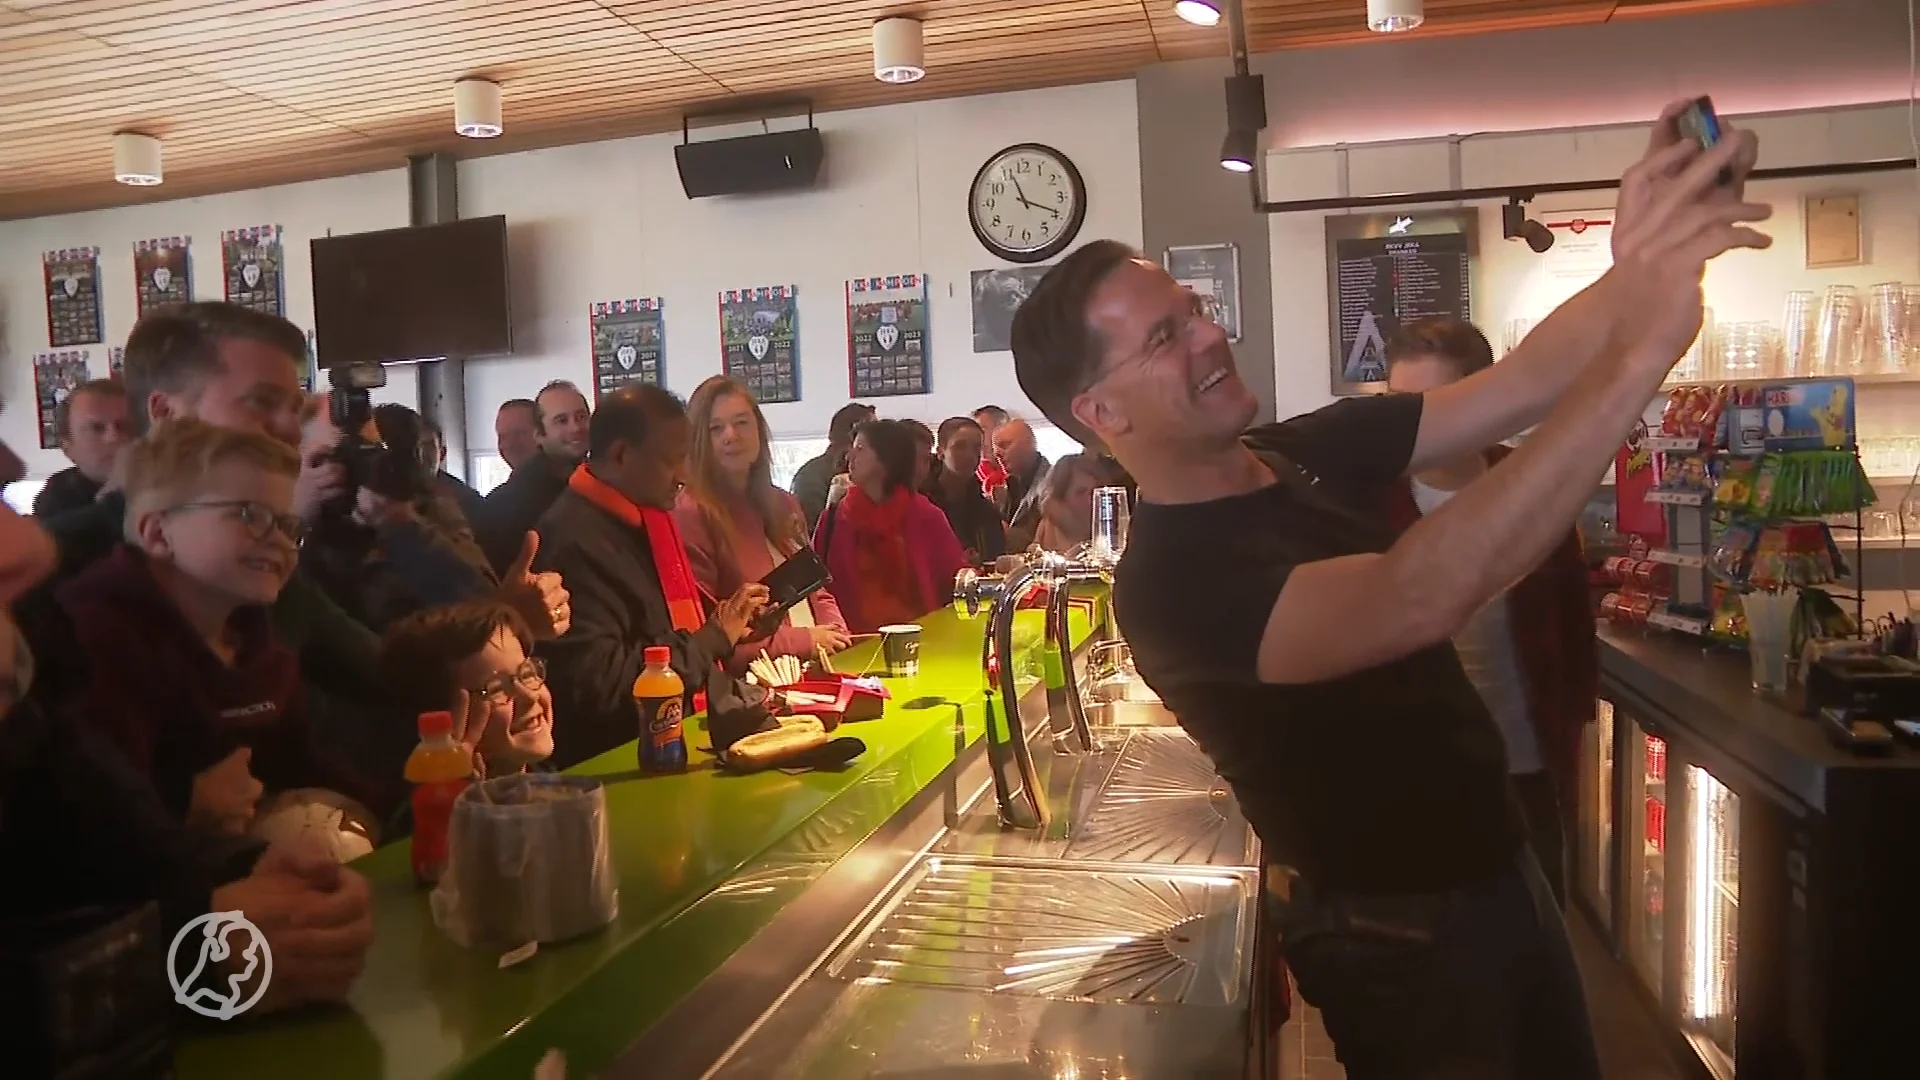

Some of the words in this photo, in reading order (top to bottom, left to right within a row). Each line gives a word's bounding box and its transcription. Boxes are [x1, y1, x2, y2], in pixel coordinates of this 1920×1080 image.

[1016, 161, 1030, 174] 12
[1002, 168, 1013, 181] 11
[991, 183, 1005, 195] 10
